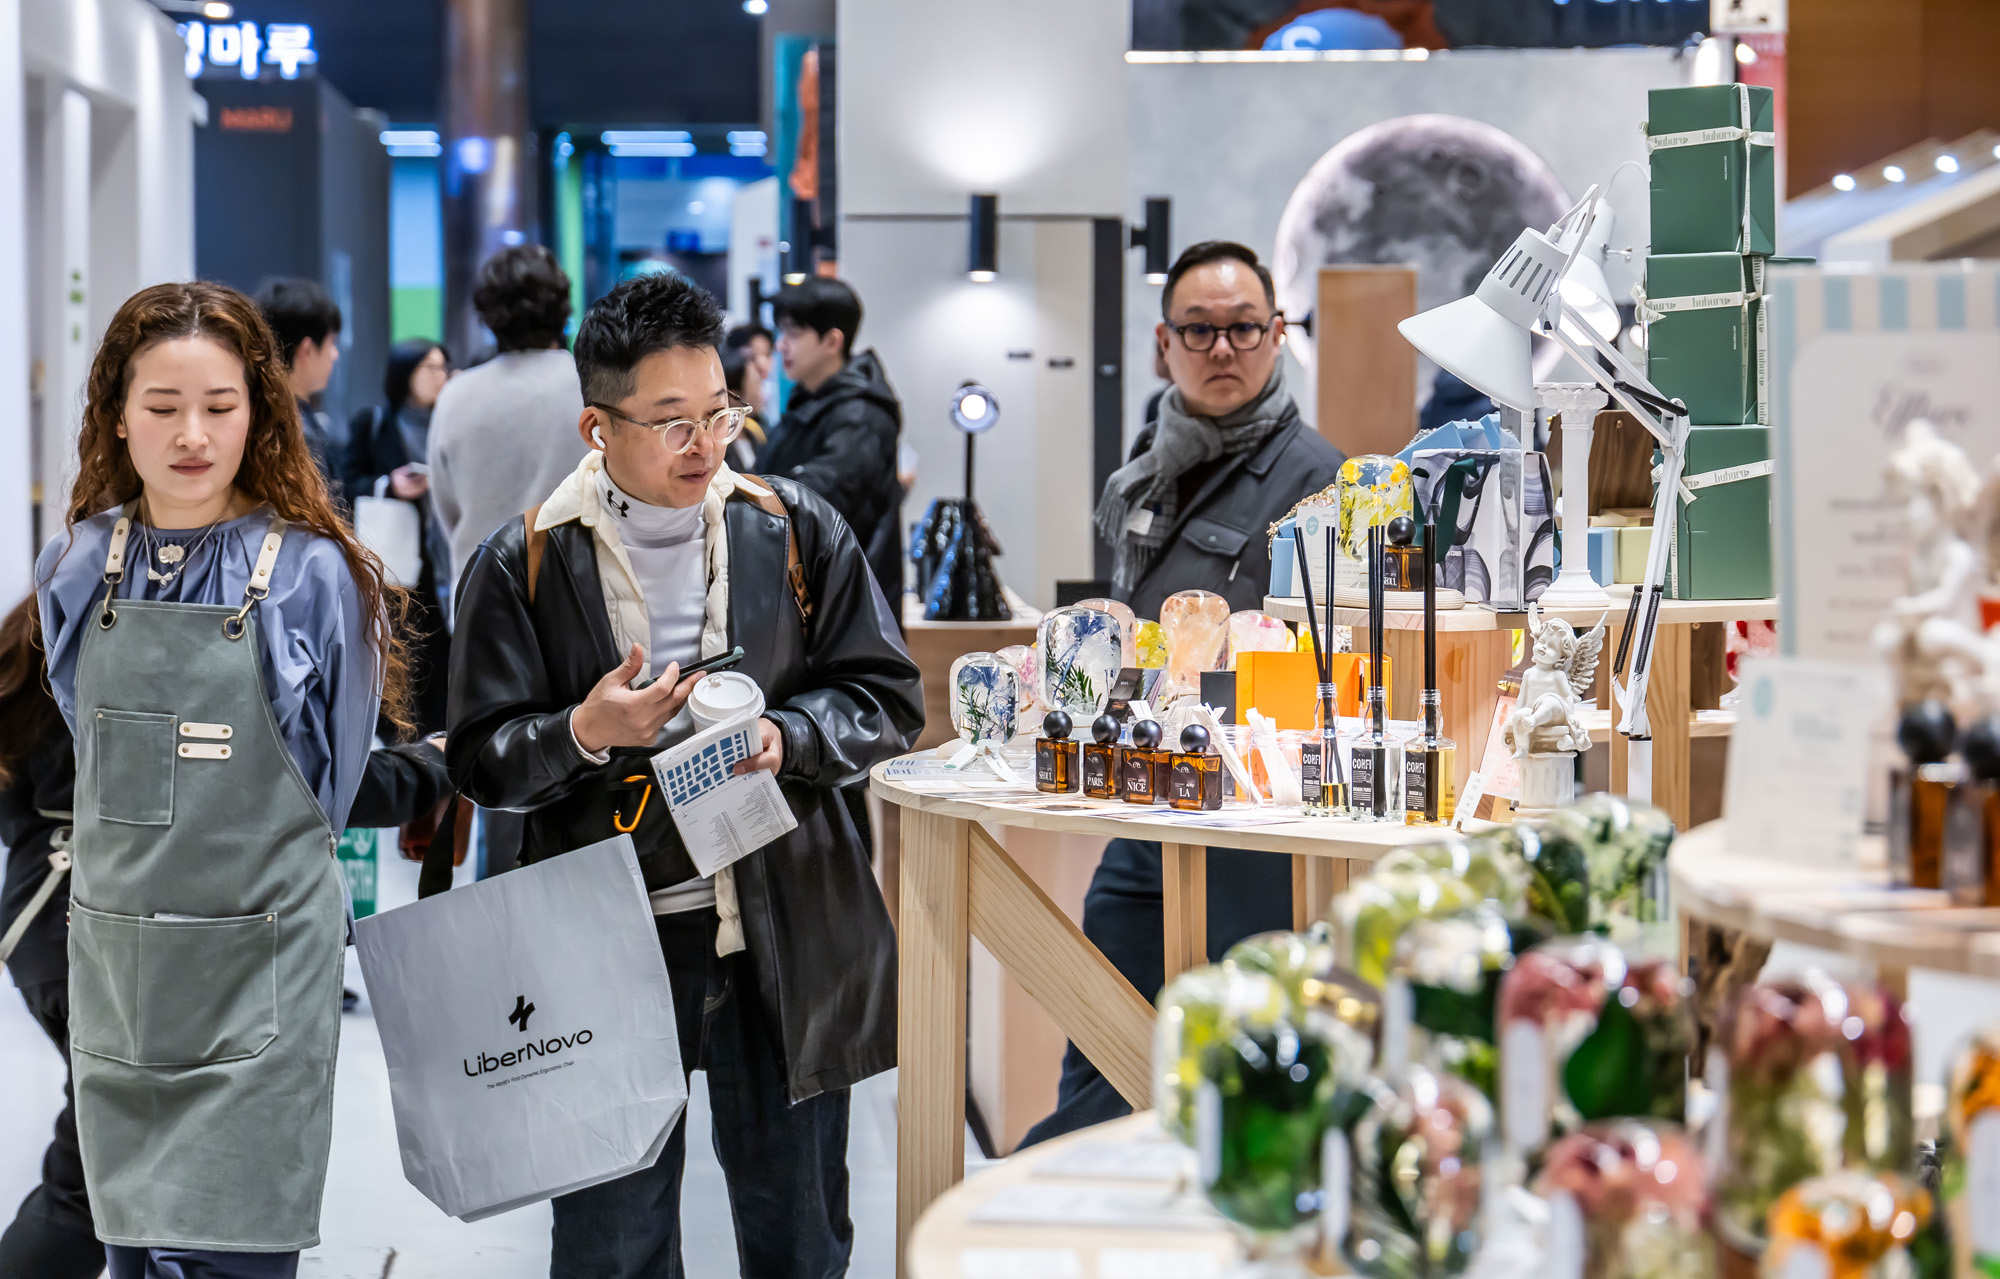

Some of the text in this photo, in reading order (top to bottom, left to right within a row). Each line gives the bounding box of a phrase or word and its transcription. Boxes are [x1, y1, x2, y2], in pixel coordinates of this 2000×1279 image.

[1038, 770, 1053, 781] SEOUL
[1087, 776, 1104, 787] PARIS
[1126, 781, 1147, 793] NICE
[1179, 787, 1190, 798] LA
[463, 1030, 593, 1077] LiberNovo
[495, 1079, 510, 1088] World's
[520, 1070, 539, 1081] Dynamic
[539, 1064, 562, 1075] Ergonomic
[563, 1060, 574, 1068] Chair
